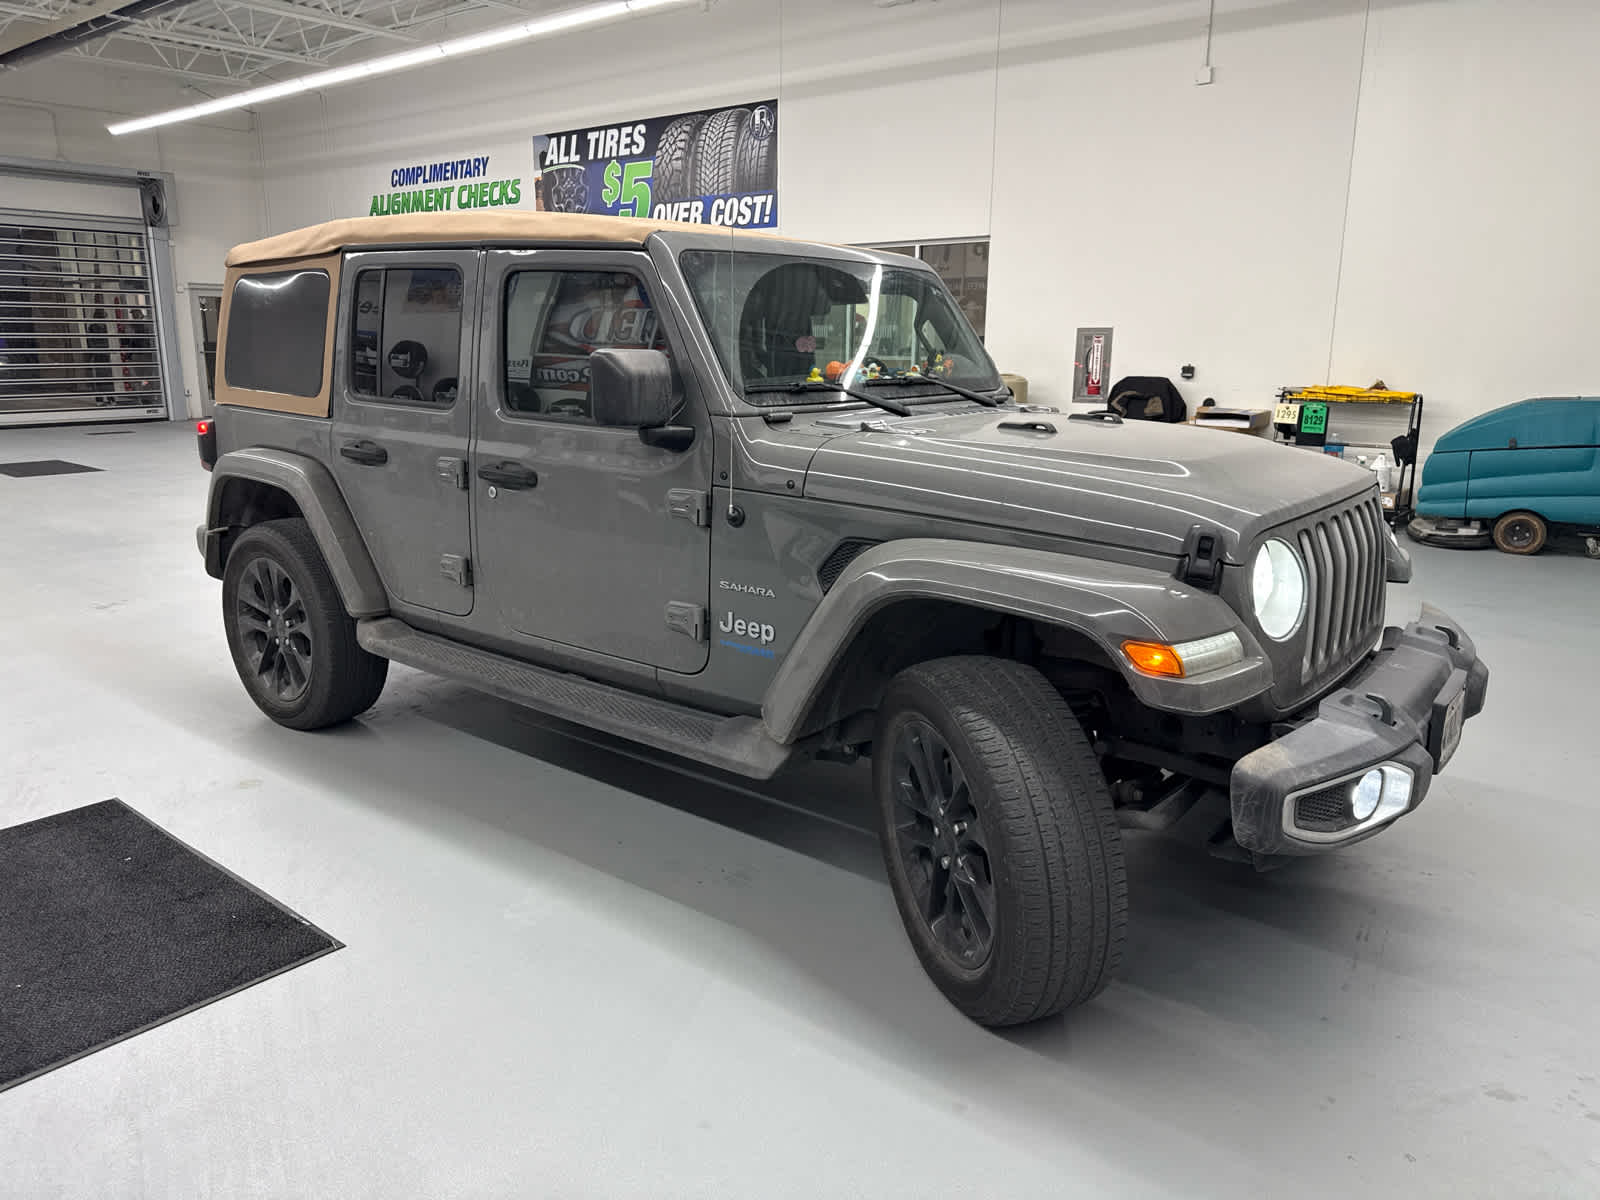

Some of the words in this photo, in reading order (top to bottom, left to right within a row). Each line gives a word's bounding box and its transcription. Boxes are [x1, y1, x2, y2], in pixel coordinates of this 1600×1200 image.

[545, 134, 580, 166] ALL
[587, 123, 646, 161] TIRES
[391, 156, 490, 188] COMPLIMENTARY
[369, 186, 454, 216] ALIGNMENT
[457, 178, 521, 209] CHECKS
[602, 159, 653, 219] $5
[653, 200, 704, 224] OVER
[710, 194, 773, 226] COST!
[1304, 415, 1324, 425] 8129
[719, 580, 776, 598] SAHARA
[719, 611, 775, 645] Jeep
